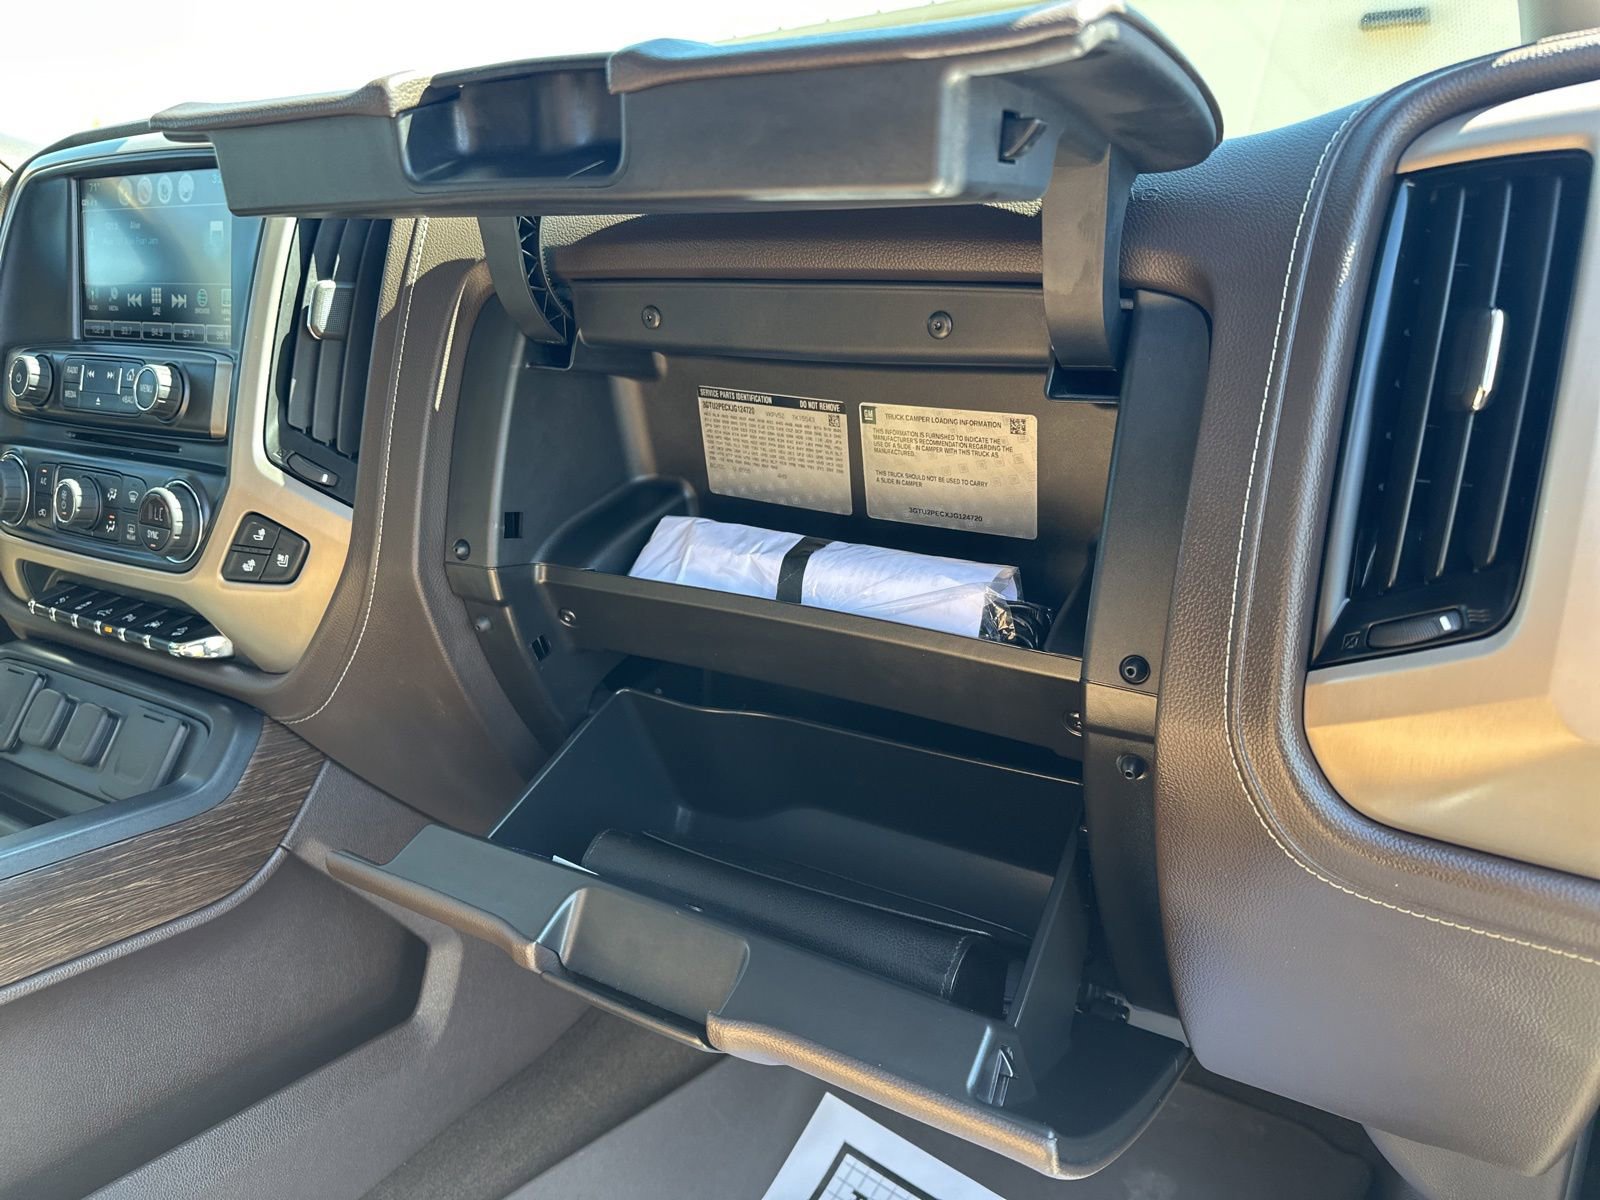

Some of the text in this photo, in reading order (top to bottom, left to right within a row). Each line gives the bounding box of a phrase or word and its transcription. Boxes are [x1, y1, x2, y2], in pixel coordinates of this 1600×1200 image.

[140, 383, 154, 393] MENU
[700, 388, 773, 405] SERVICE PARTS IDENTIFICATION
[799, 400, 841, 413] DO NOT REMOVE
[885, 413, 1002, 429] TRUCK CAMPER LOADING INFORMATION
[873, 427, 885, 435] THIS
[884, 428, 919, 438] INFORMATION
[925, 432, 955, 441] FURNISHED
[956, 434, 964, 442] TO
[964, 435, 989, 444] INDICATE
[873, 434, 1013, 453] MANUFACTURER'S RECOMMENDATION REGARDING THE
[897, 443, 912, 451] SLIDE
[921, 445, 944, 454] CAMPER
[944, 447, 958, 455] WITH
[958, 448, 971, 456] THIS
[971, 450, 991, 458] TRUCK
[991, 451, 999, 459] AS
[875, 469, 887, 477] THIS
[905, 473, 926, 481] SHOULD
[946, 477, 961, 485] USED
[969, 480, 988, 488] CARRY
[901, 479, 923, 488] CAMPER
[909, 507, 983, 522] 3GTU2PECXJG124720
[147, 529, 159, 540] SYNC
